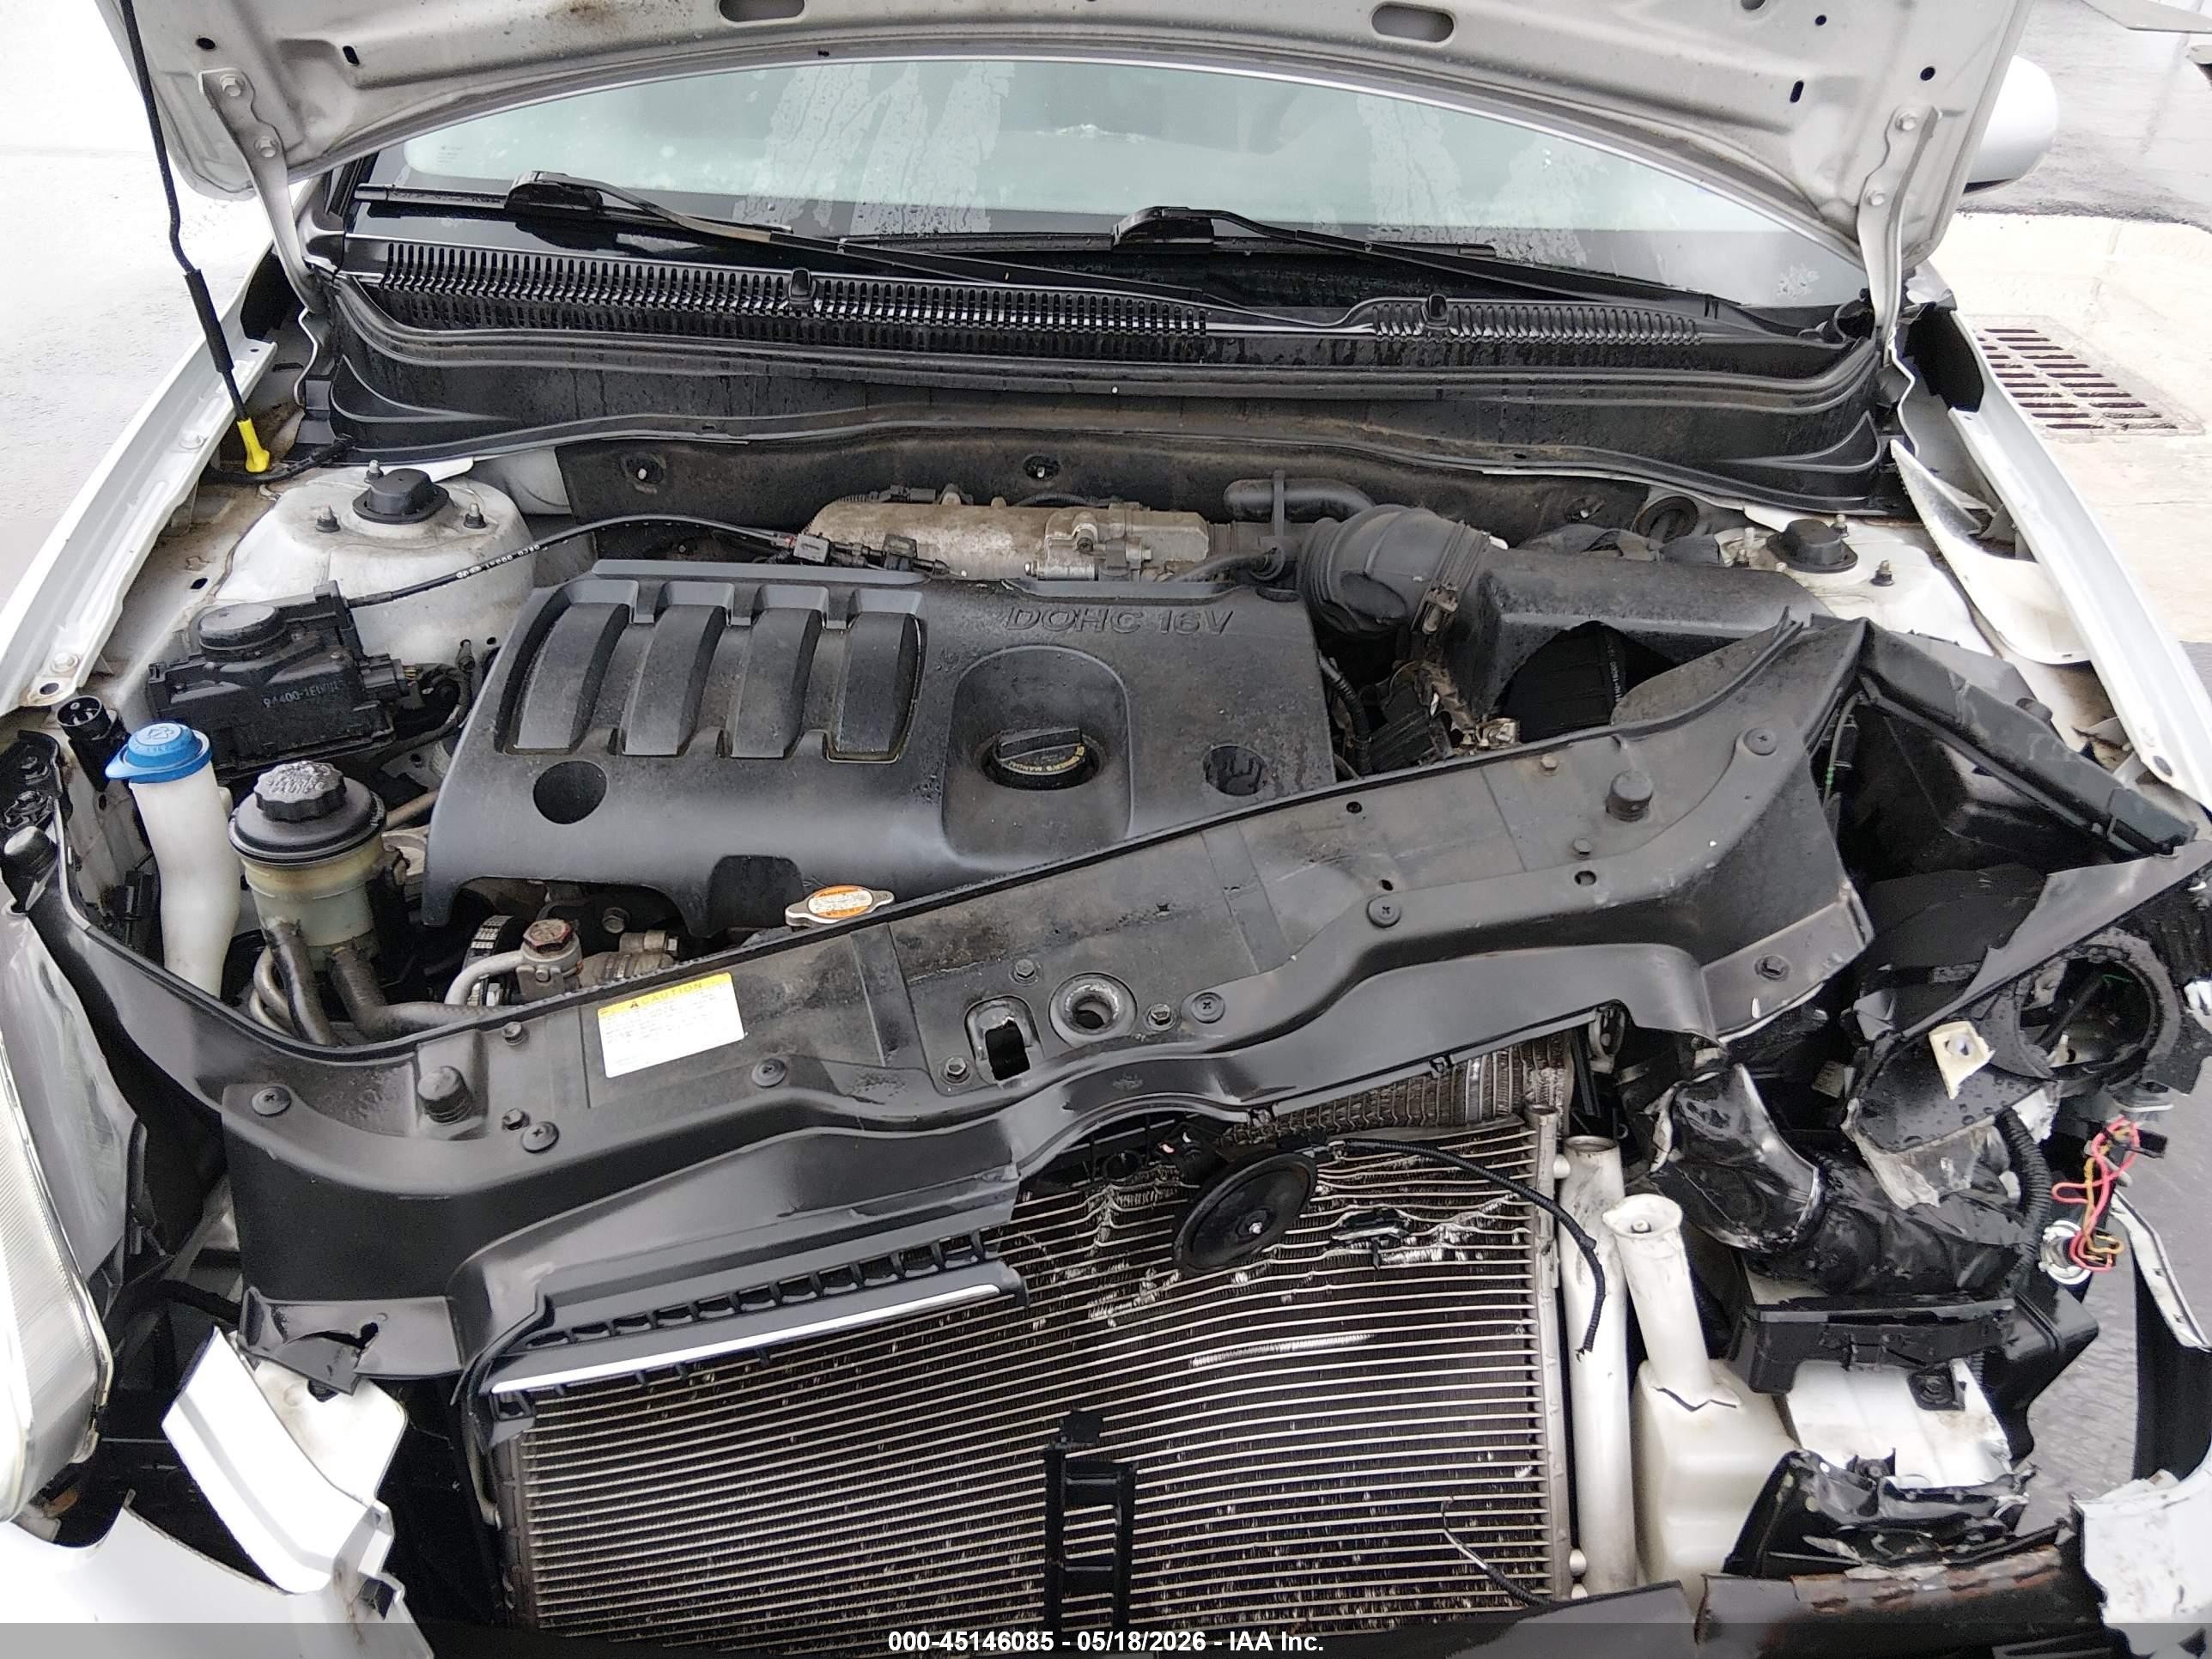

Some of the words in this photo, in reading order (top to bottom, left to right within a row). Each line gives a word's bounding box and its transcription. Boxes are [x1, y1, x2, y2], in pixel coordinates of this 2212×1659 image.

[1006, 606, 1144, 634] DOHC
[1160, 610, 1234, 635] 16V
[641, 982, 702, 1005] CAUTION
